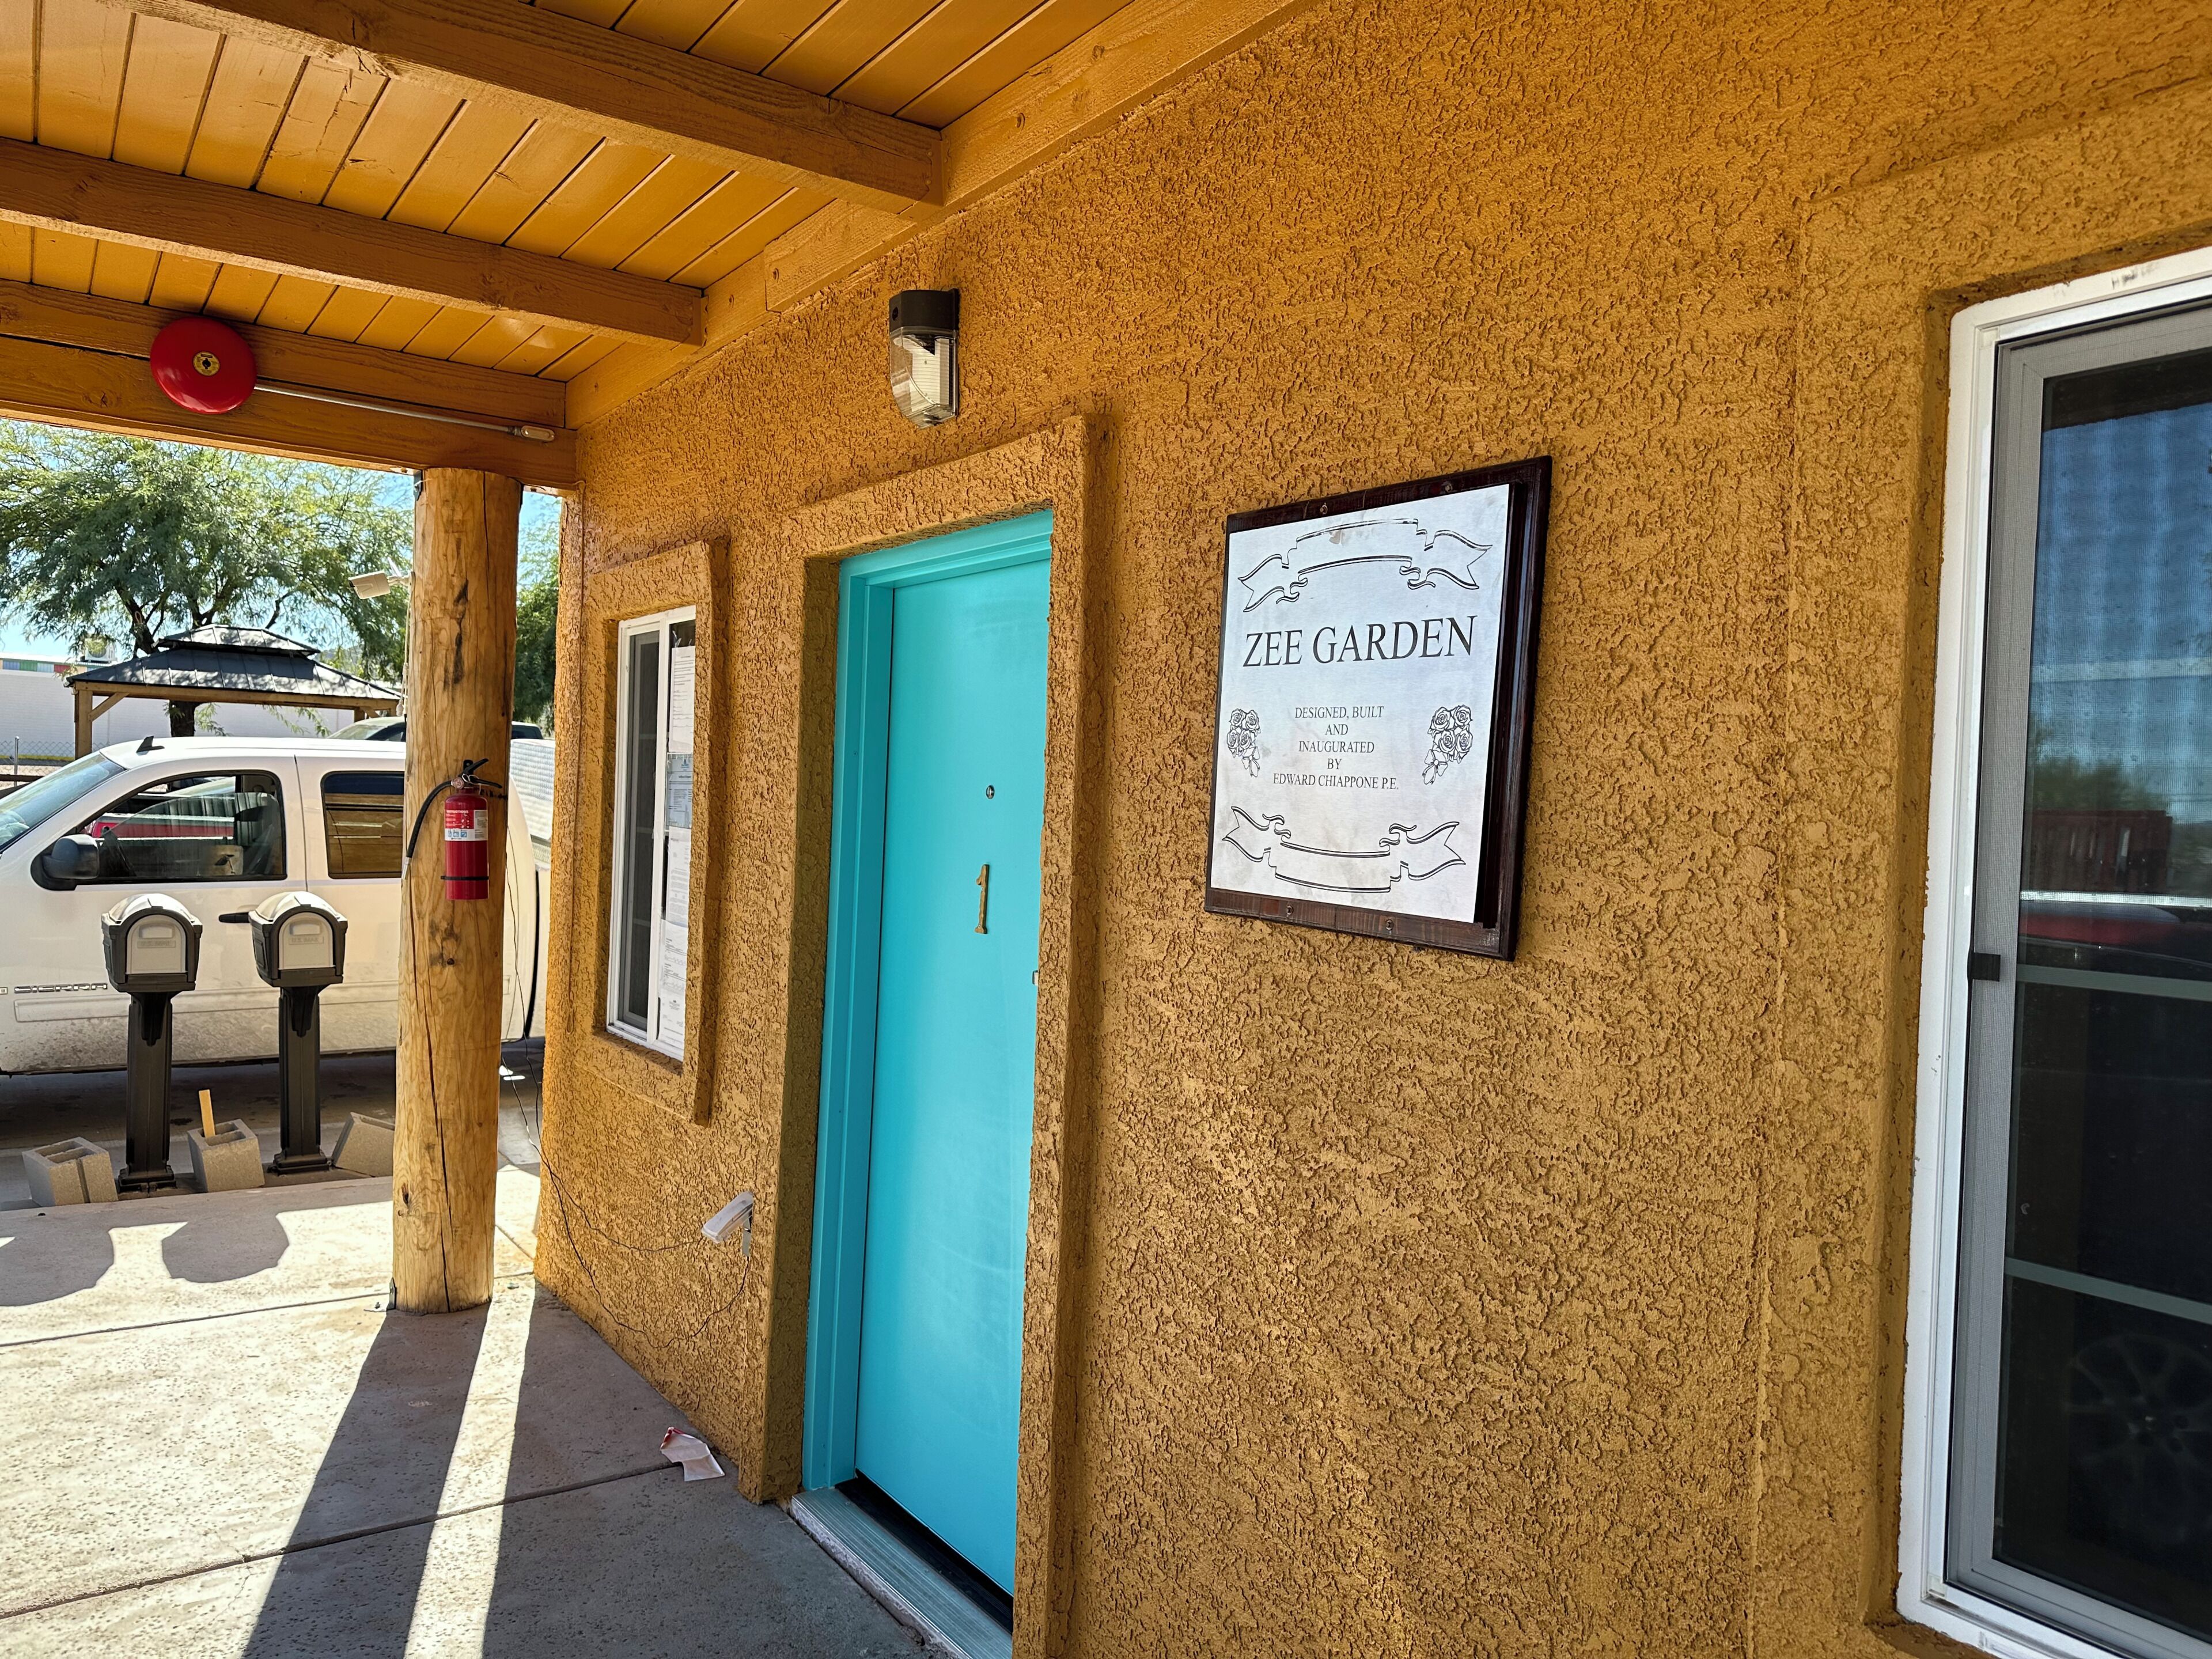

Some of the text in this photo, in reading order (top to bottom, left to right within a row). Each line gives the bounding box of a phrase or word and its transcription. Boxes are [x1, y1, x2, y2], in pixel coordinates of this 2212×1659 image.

[1243, 615, 1478, 667] ZEE GARDEN
[1294, 706, 1384, 719] DESIGNED, BUILT
[1325, 724, 1349, 736] AND
[1298, 741, 1374, 753] INAUGURATED
[1327, 758, 1342, 770] BY
[1272, 772, 1399, 790] EDWARD CHIAPPONE P.E.
[975, 864, 990, 934] 1
